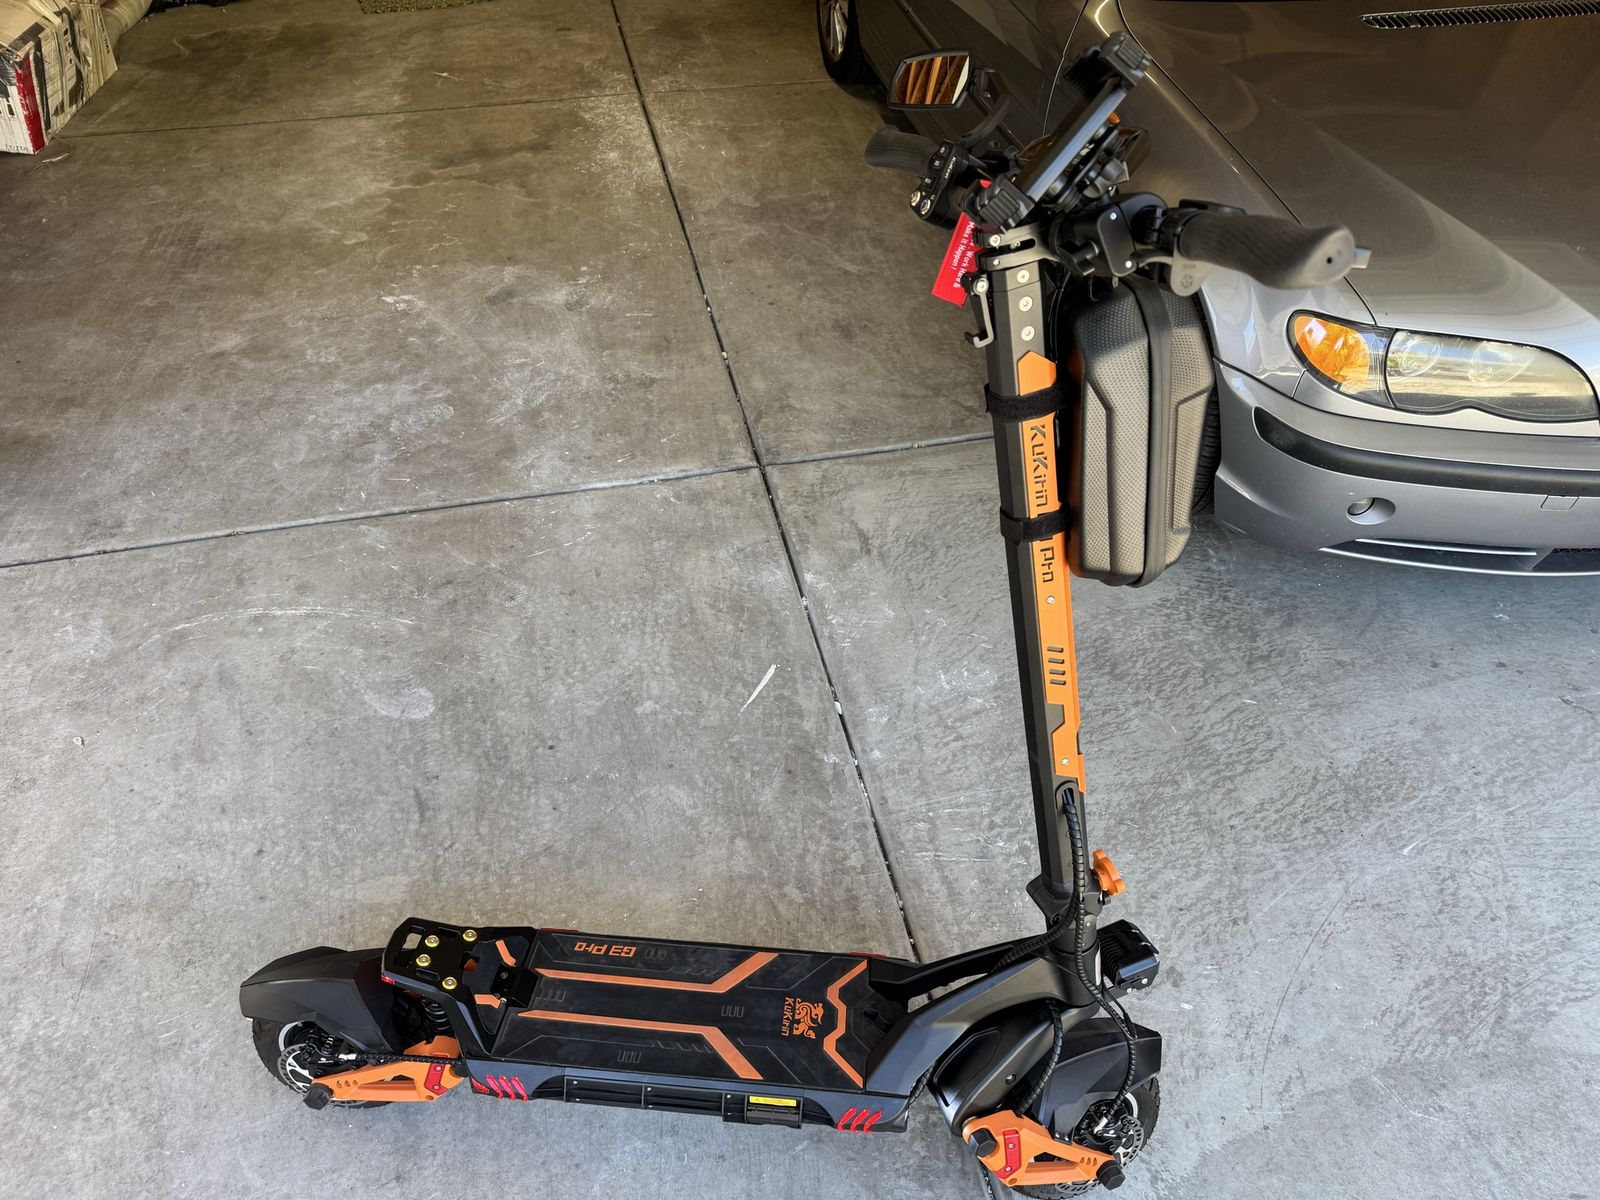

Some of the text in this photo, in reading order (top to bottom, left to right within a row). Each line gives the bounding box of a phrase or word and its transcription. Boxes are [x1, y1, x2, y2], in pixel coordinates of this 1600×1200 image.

[962, 220, 976, 238] Make
[961, 250, 974, 268] Work
[1030, 424, 1048, 507] KuKirin
[1040, 546, 1055, 583] Pro
[574, 942, 637, 957] G3 Pro
[781, 997, 794, 1037] KuKirin
